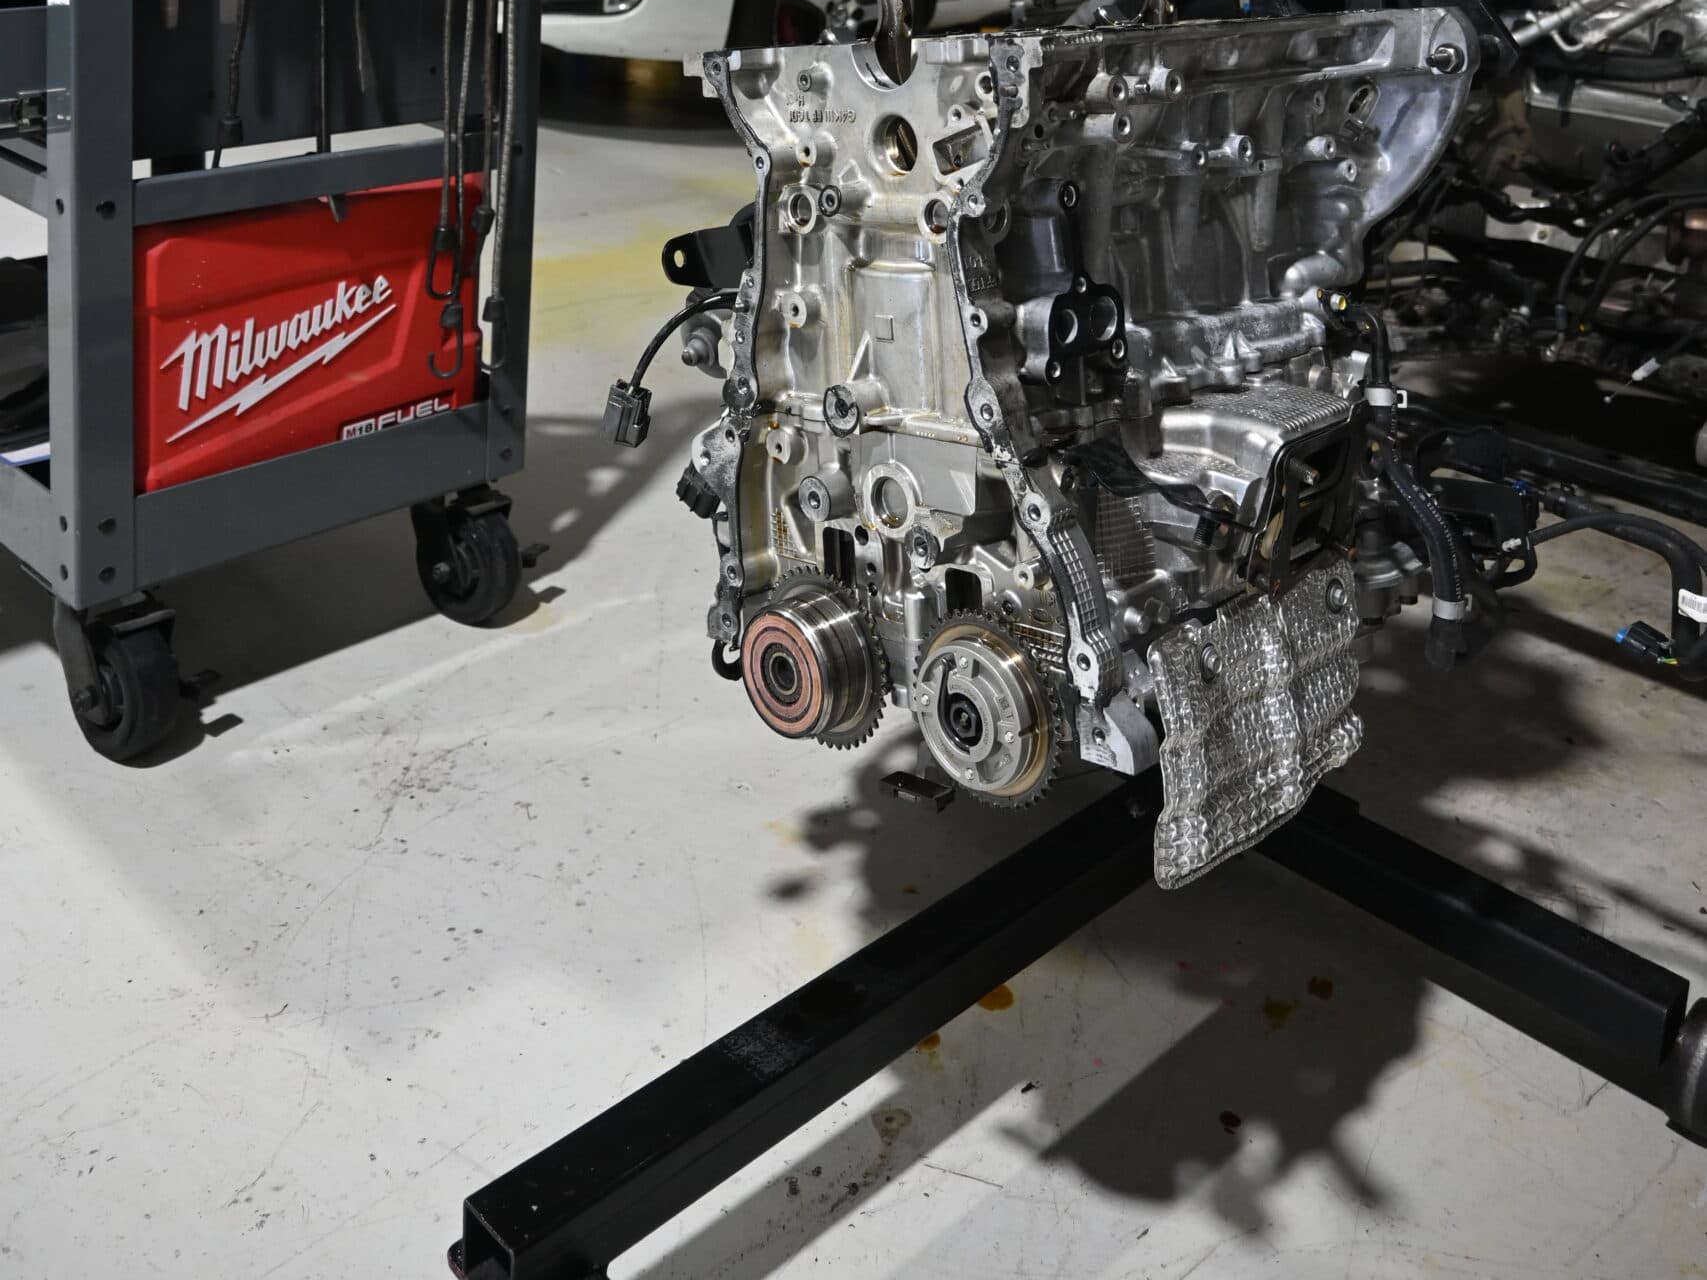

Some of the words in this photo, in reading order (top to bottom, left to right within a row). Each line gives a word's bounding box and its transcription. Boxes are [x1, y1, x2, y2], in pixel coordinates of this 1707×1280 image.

[160, 275, 392, 411] Milwaukee
[345, 423, 374, 439] M18
[378, 398, 450, 430] FUEL
